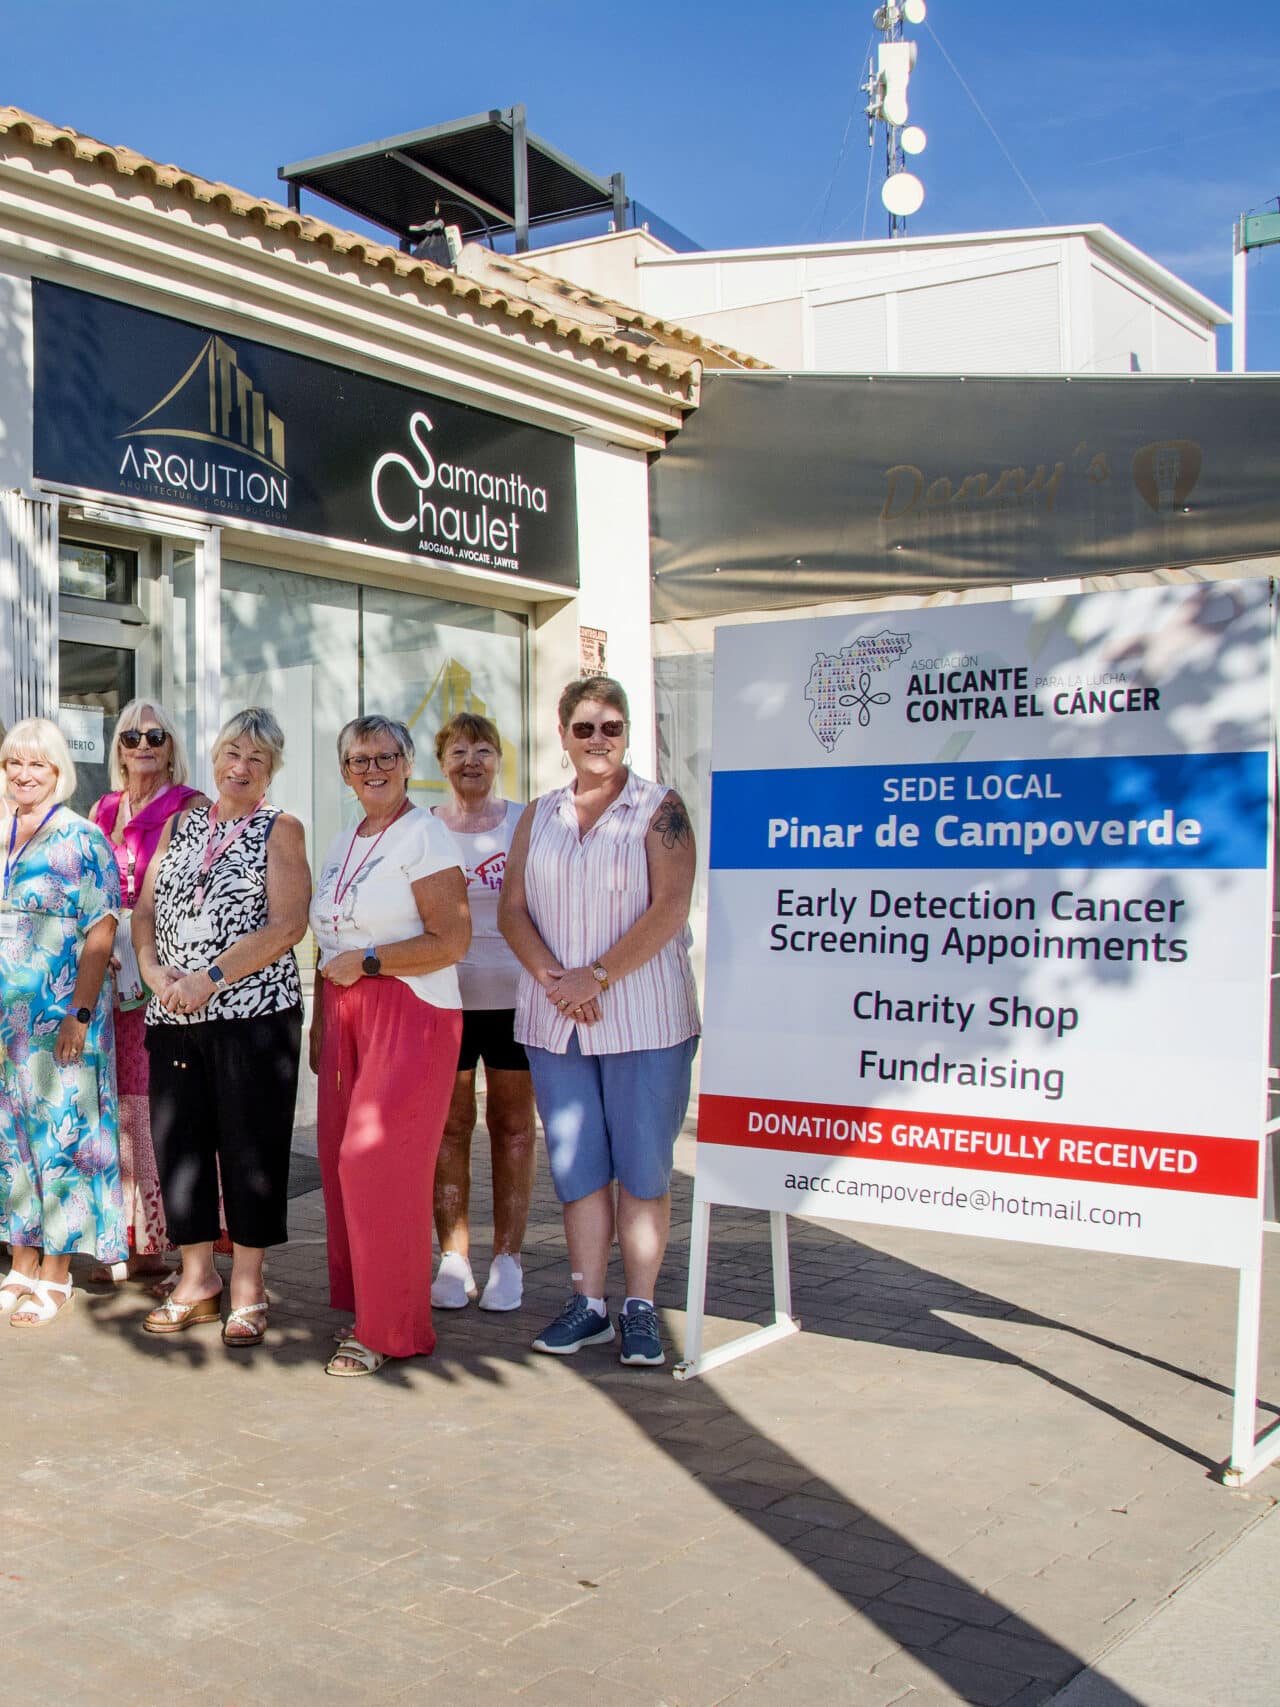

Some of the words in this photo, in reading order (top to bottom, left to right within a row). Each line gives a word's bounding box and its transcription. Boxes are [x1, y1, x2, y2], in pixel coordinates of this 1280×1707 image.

[119, 443, 288, 509] ARQUITION
[409, 411, 548, 513] Samantha
[371, 452, 520, 554] Chaulet
[418, 540, 454, 557] ABOGADA
[458, 548, 491, 564] AVOCATE
[494, 556, 520, 570] LAWYER
[906, 667, 1029, 697] ALICANTE
[910, 654, 979, 671] ASOCIACIÓN
[1034, 675, 1065, 688] PARA
[1067, 674, 1082, 688] LA
[1086, 672, 1128, 686] LUCHA
[905, 697, 1008, 723] CONTRA
[1014, 694, 1045, 718] EL
[1053, 687, 1162, 717] CÁNCER
[882, 775, 955, 802] SEDE
[965, 773, 1062, 800] LOCAL
[767, 817, 863, 849] Pinar
[874, 814, 920, 848] de
[934, 808, 1202, 855] Campoverde
[775, 887, 857, 925] Early
[868, 889, 1036, 921] Detection
[1050, 890, 1185, 923] Cancer
[769, 923, 930, 962] Screening
[941, 927, 1189, 965] Appoinments
[852, 990, 975, 1032] Charity
[987, 995, 1079, 1038] Shop
[858, 1049, 1065, 1100] Fundraising
[747, 1111, 883, 1145] DONATIONS
[890, 1123, 1051, 1160] GRATEFULLY
[1058, 1138, 1199, 1175] RECEIVED
[783, 1171, 1143, 1229] aacc.campoverde@hotmail.com
